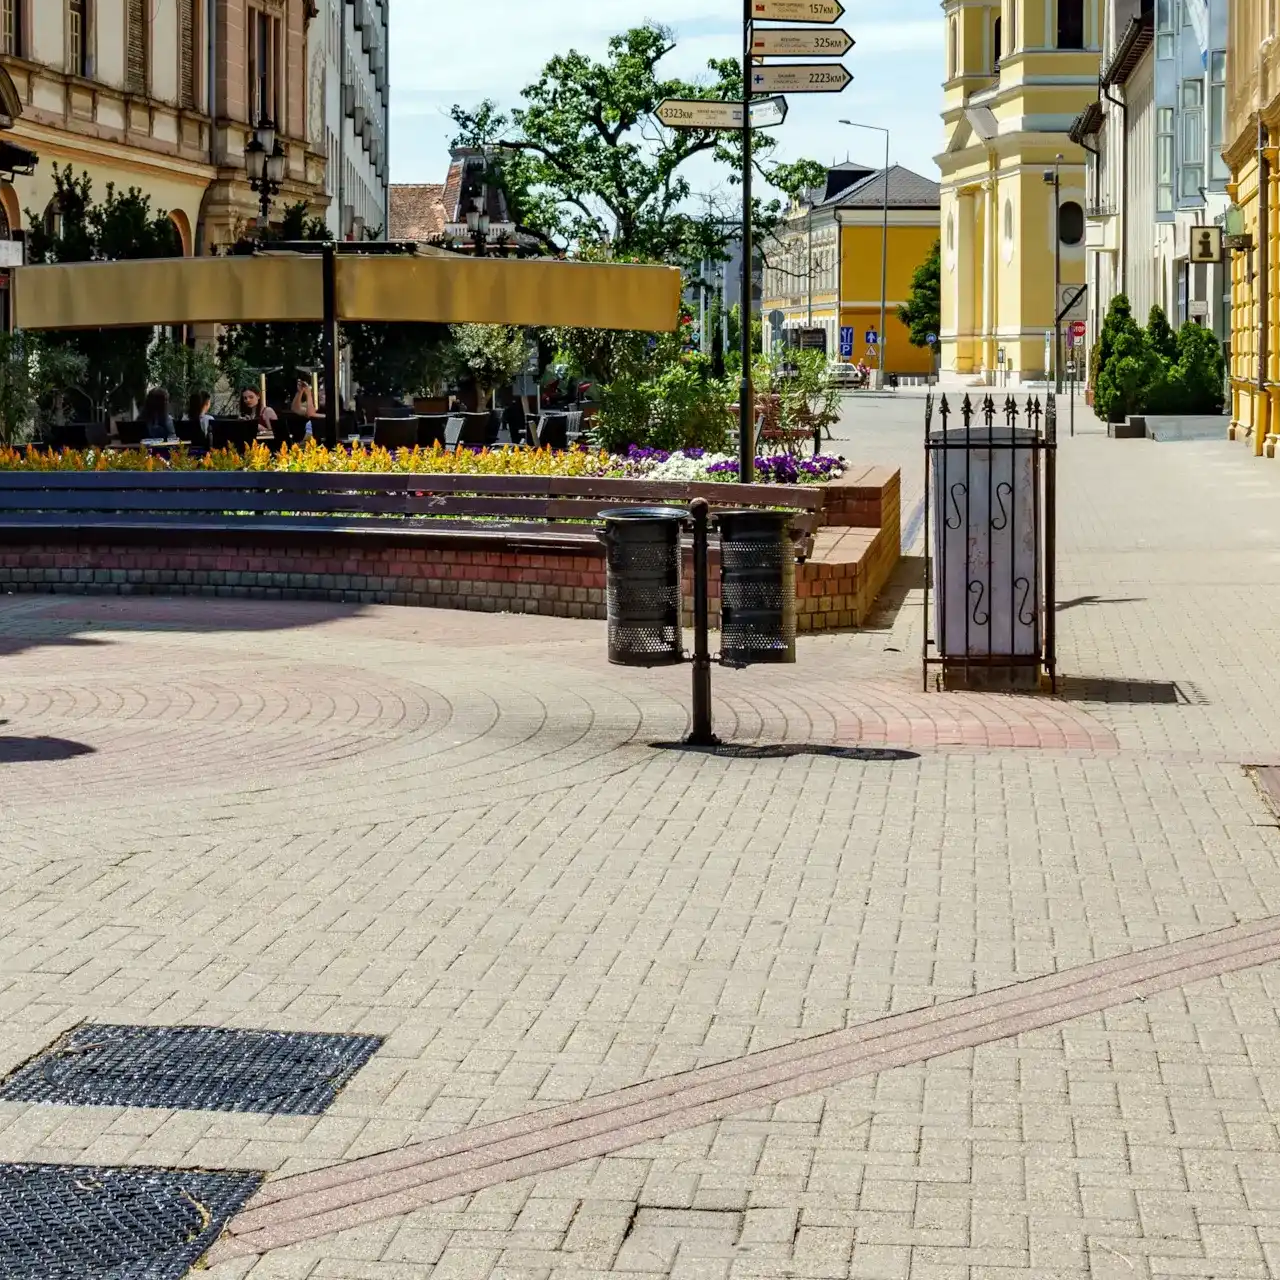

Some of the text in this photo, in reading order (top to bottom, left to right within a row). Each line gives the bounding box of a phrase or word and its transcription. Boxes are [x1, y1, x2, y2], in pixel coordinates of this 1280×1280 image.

[808, 4, 834, 14] 157KM
[813, 37, 842, 48] 325KM
[808, 73, 842, 83] 2223KM
[663, 107, 693, 119] 3323KM
